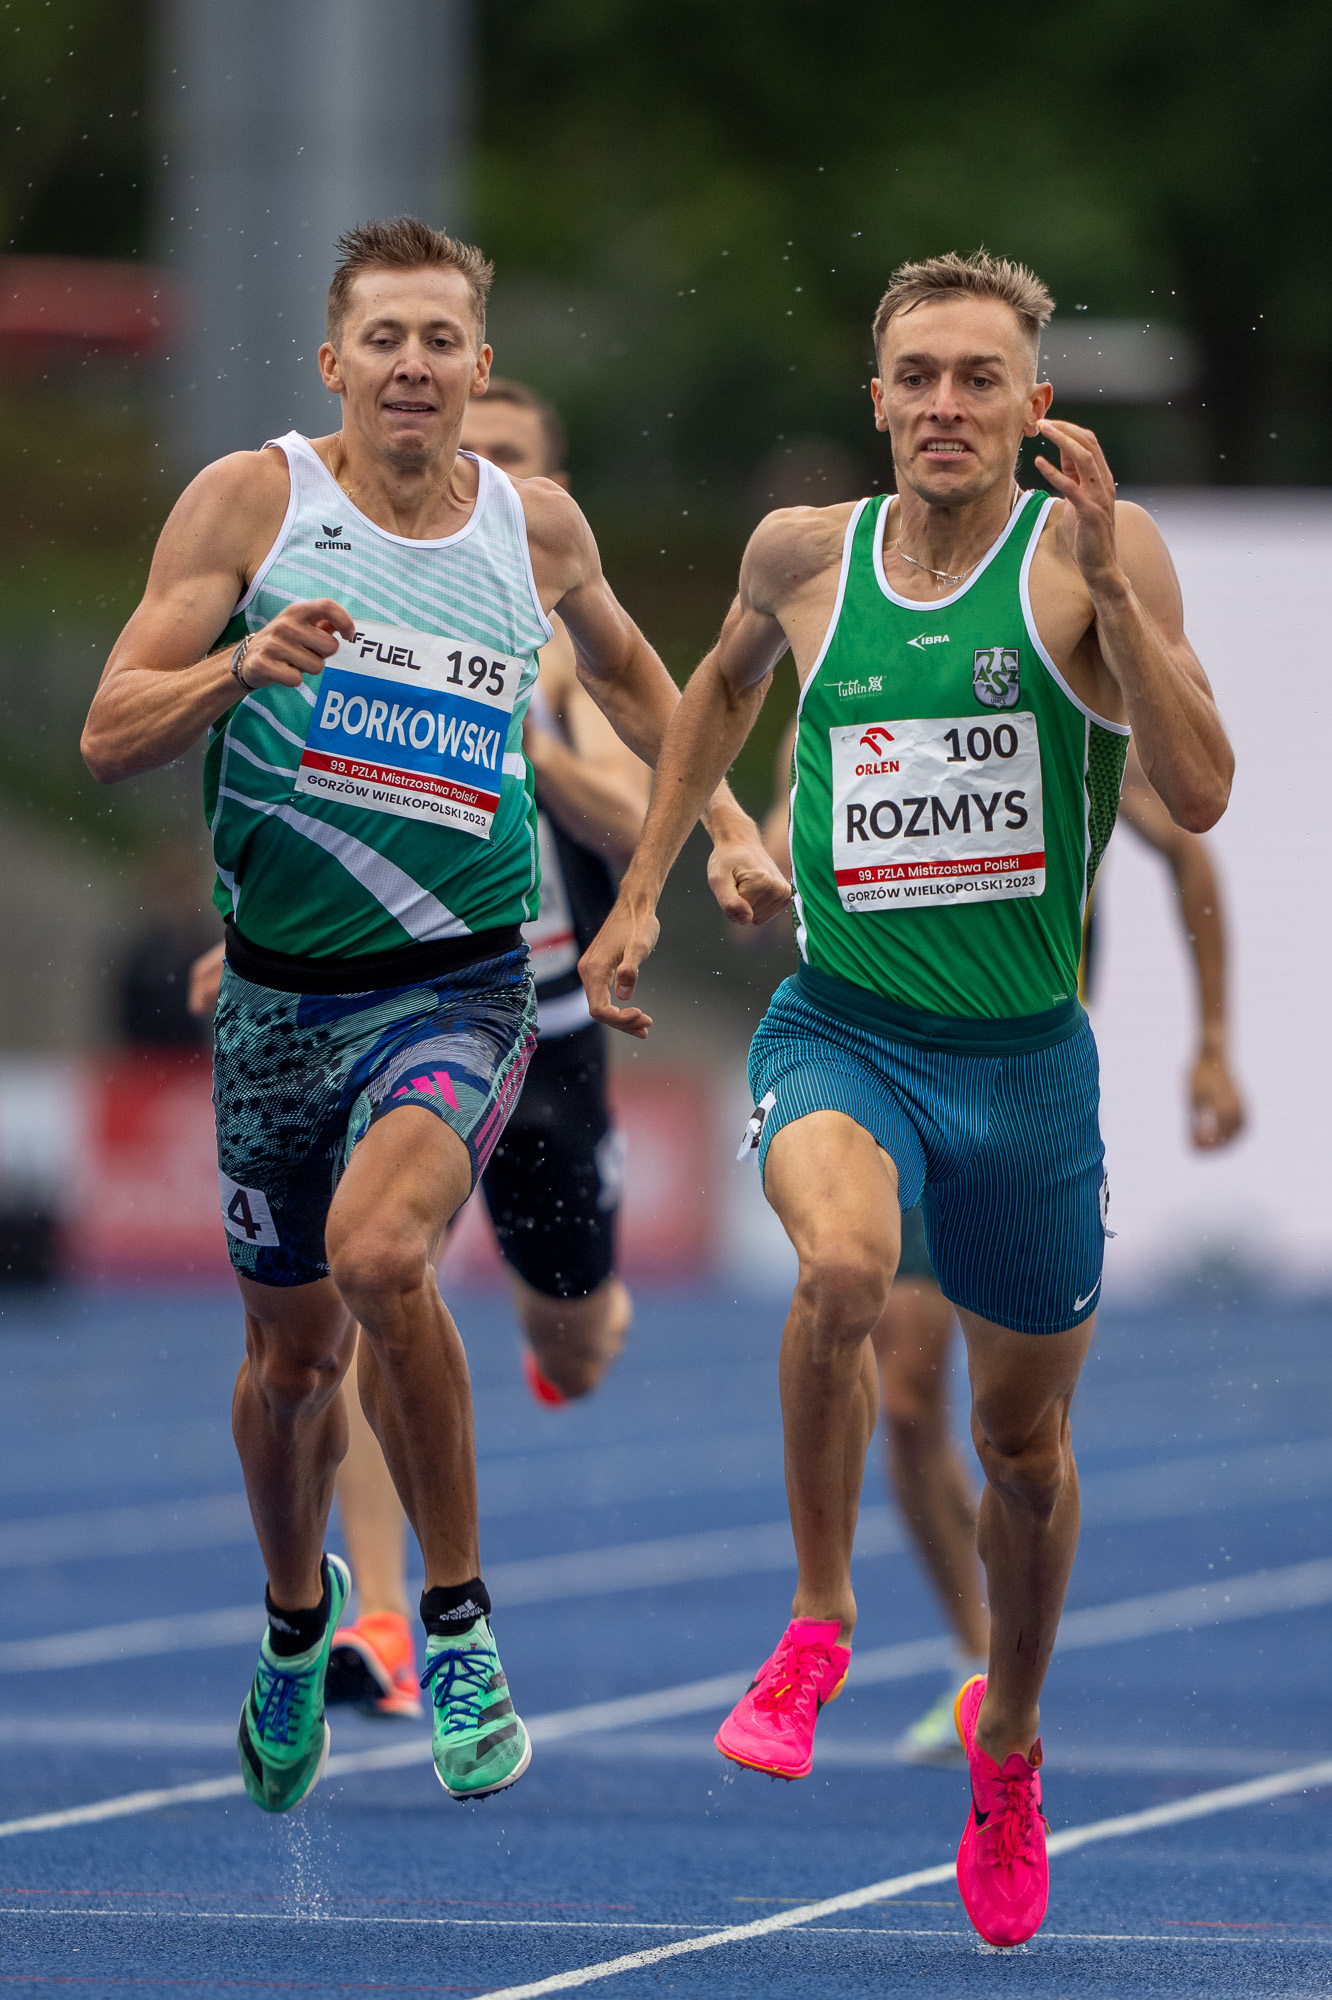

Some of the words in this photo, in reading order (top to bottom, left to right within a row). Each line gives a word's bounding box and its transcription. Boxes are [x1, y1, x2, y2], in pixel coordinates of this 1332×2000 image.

[315, 540, 352, 551] erima
[360, 640, 421, 671] FUEL
[446, 650, 507, 697] 195
[319, 690, 501, 771] BORKOWSKI
[943, 724, 1019, 762] 100
[330, 760, 348, 774] 99.
[350, 764, 379, 780] PZLA
[381, 771, 450, 796] Mistrzostwa
[450, 787, 479, 804] Polski
[855, 760, 900, 776] ORLEN
[307, 775, 370, 797] GORZÓW
[372, 789, 461, 819] WIELKOPOLSKI
[463, 811, 486, 827] 2023
[846, 790, 1028, 843] ROZMYS
[847, 886, 900, 902] GORZÓW
[903, 879, 1003, 897] WIELKOPOLSKI
[1005, 875, 1036, 889] 2023
[858, 870, 875, 881] 99.
[877, 867, 905, 880] PZLA
[908, 863, 981, 877] Mistrzostwa
[984, 857, 1019, 872] Polski
[227, 1188, 262, 1240] 4
